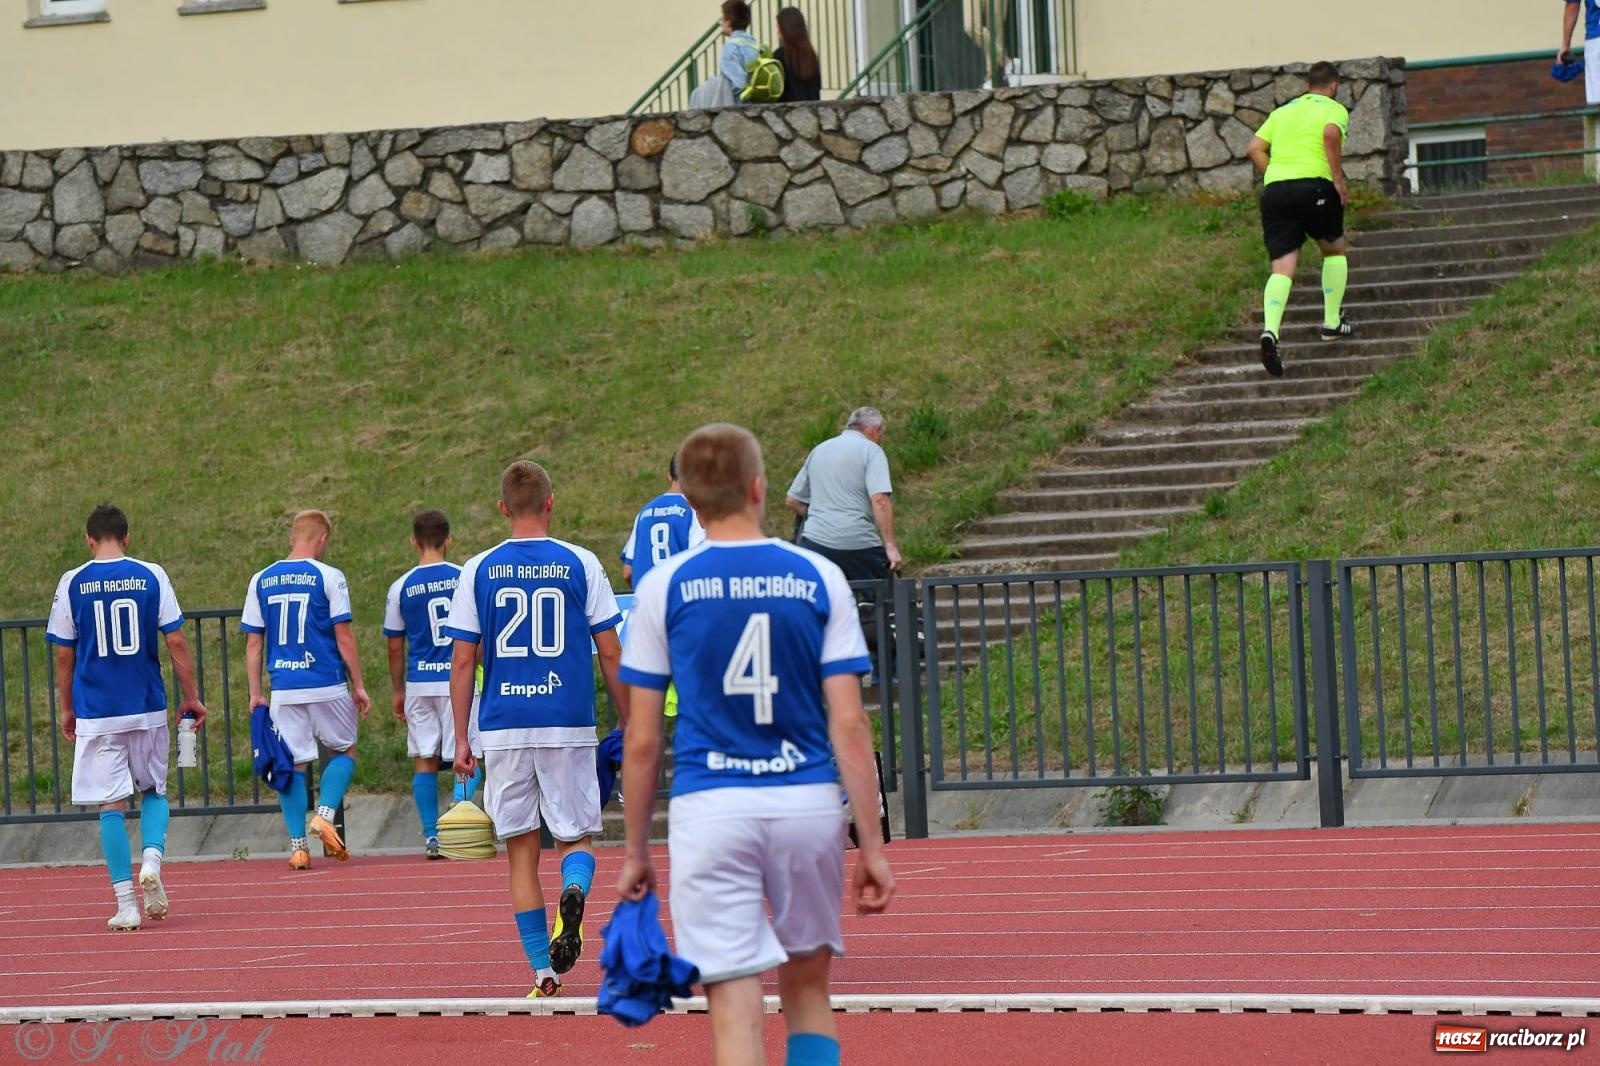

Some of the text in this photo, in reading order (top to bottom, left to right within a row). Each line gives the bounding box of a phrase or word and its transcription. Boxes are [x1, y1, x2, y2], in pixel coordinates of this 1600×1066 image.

[650, 522, 671, 567] 8
[79, 576, 147, 595] UNIA RACIBÓRZ
[261, 571, 317, 589] UNIA RACIBÓRZ
[488, 561, 571, 580] UNIA RACIBÓRZ
[680, 572, 818, 604] UNIA RACIBÓRZ
[406, 583, 426, 598] UNIA
[93, 598, 140, 658] 10
[267, 593, 310, 646] 77
[427, 596, 454, 647] 6
[495, 587, 565, 658] 20
[417, 660, 452, 673] Empo
[723, 612, 779, 725] 4
